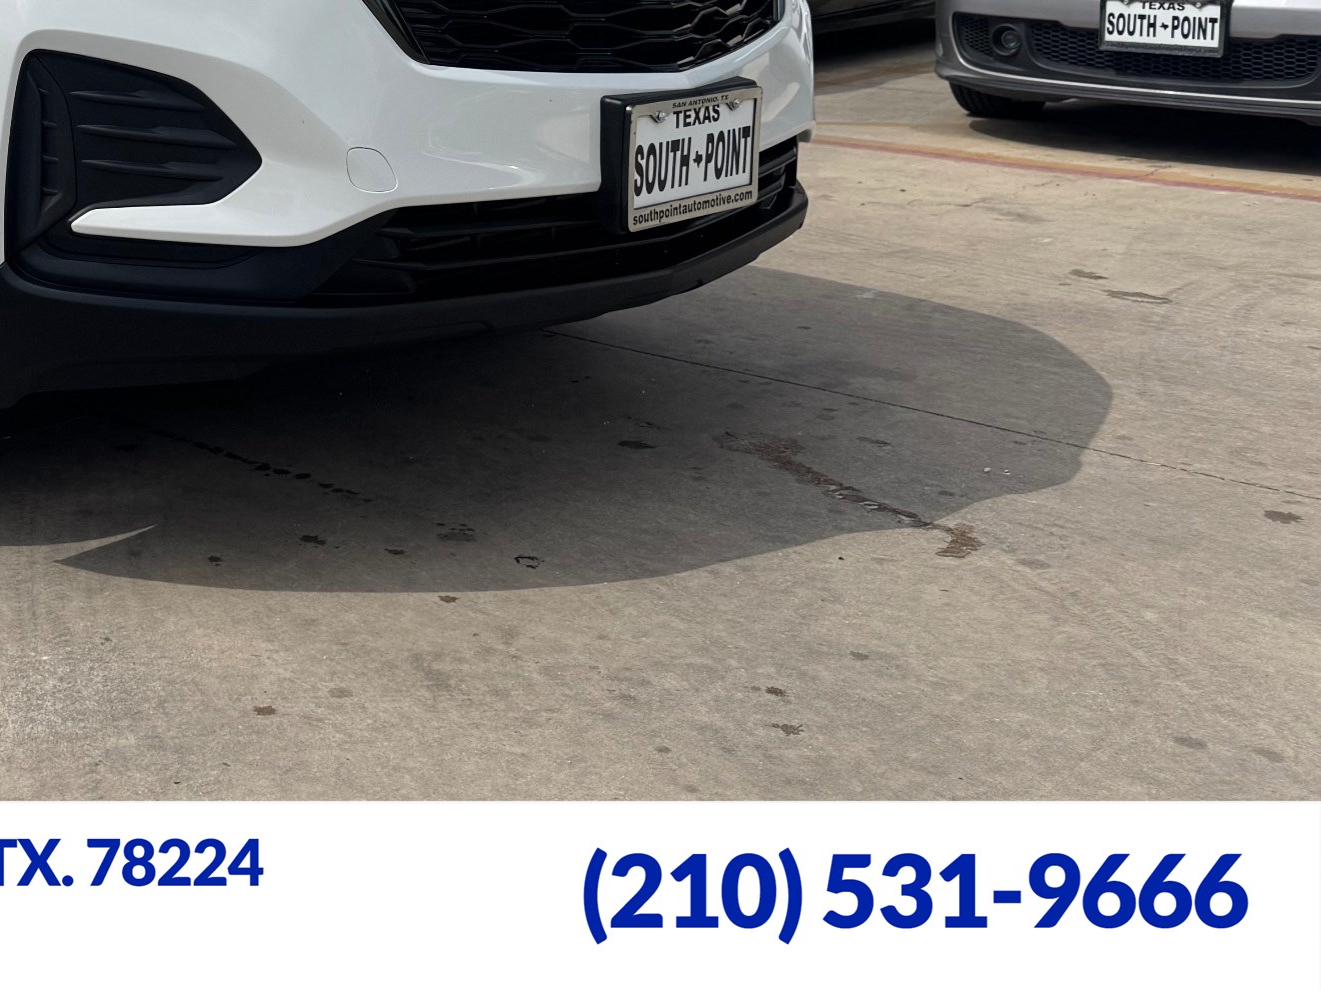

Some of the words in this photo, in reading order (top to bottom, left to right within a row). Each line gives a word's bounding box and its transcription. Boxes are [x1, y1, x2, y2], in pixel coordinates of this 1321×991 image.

[1140, 0, 1186, 12] TEXAS
[1106, 12, 1157, 37] SOUTH
[1171, 15, 1218, 41] POINT
[673, 104, 721, 129] TEXAS
[633, 137, 692, 197] SOUTH
[703, 125, 751, 182] POINT
[632, 190, 753, 226] southpointautomotive.com
